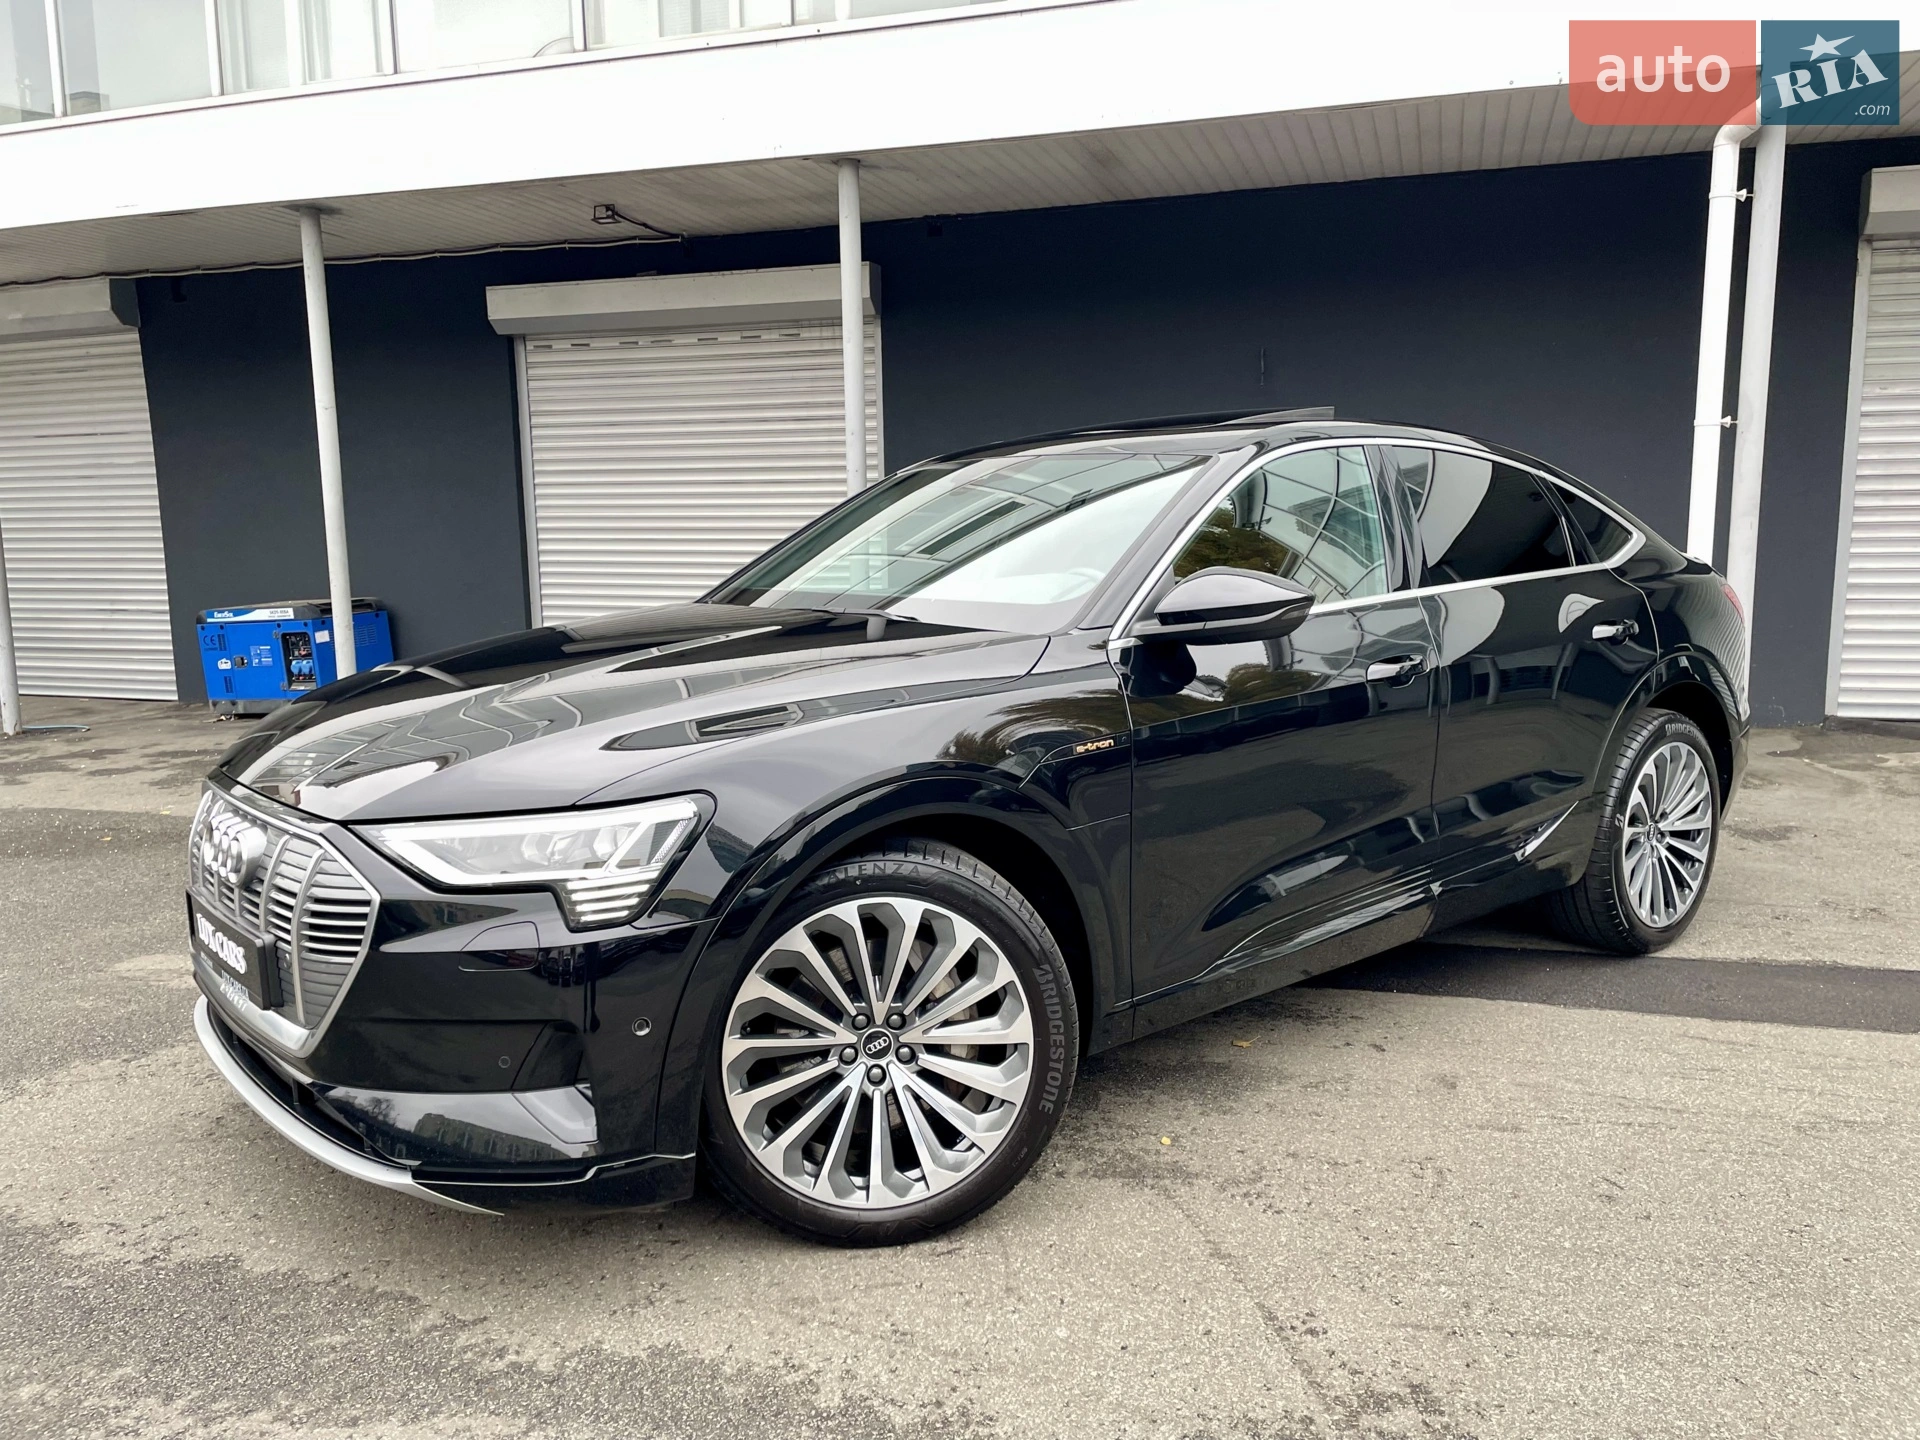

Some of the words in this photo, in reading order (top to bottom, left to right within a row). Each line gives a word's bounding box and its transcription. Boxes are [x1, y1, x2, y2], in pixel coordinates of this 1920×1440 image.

[1076, 739, 1115, 753] e-tron
[827, 863, 921, 884] ALENZA
[1032, 964, 1065, 1114] BRIDGESTONE
